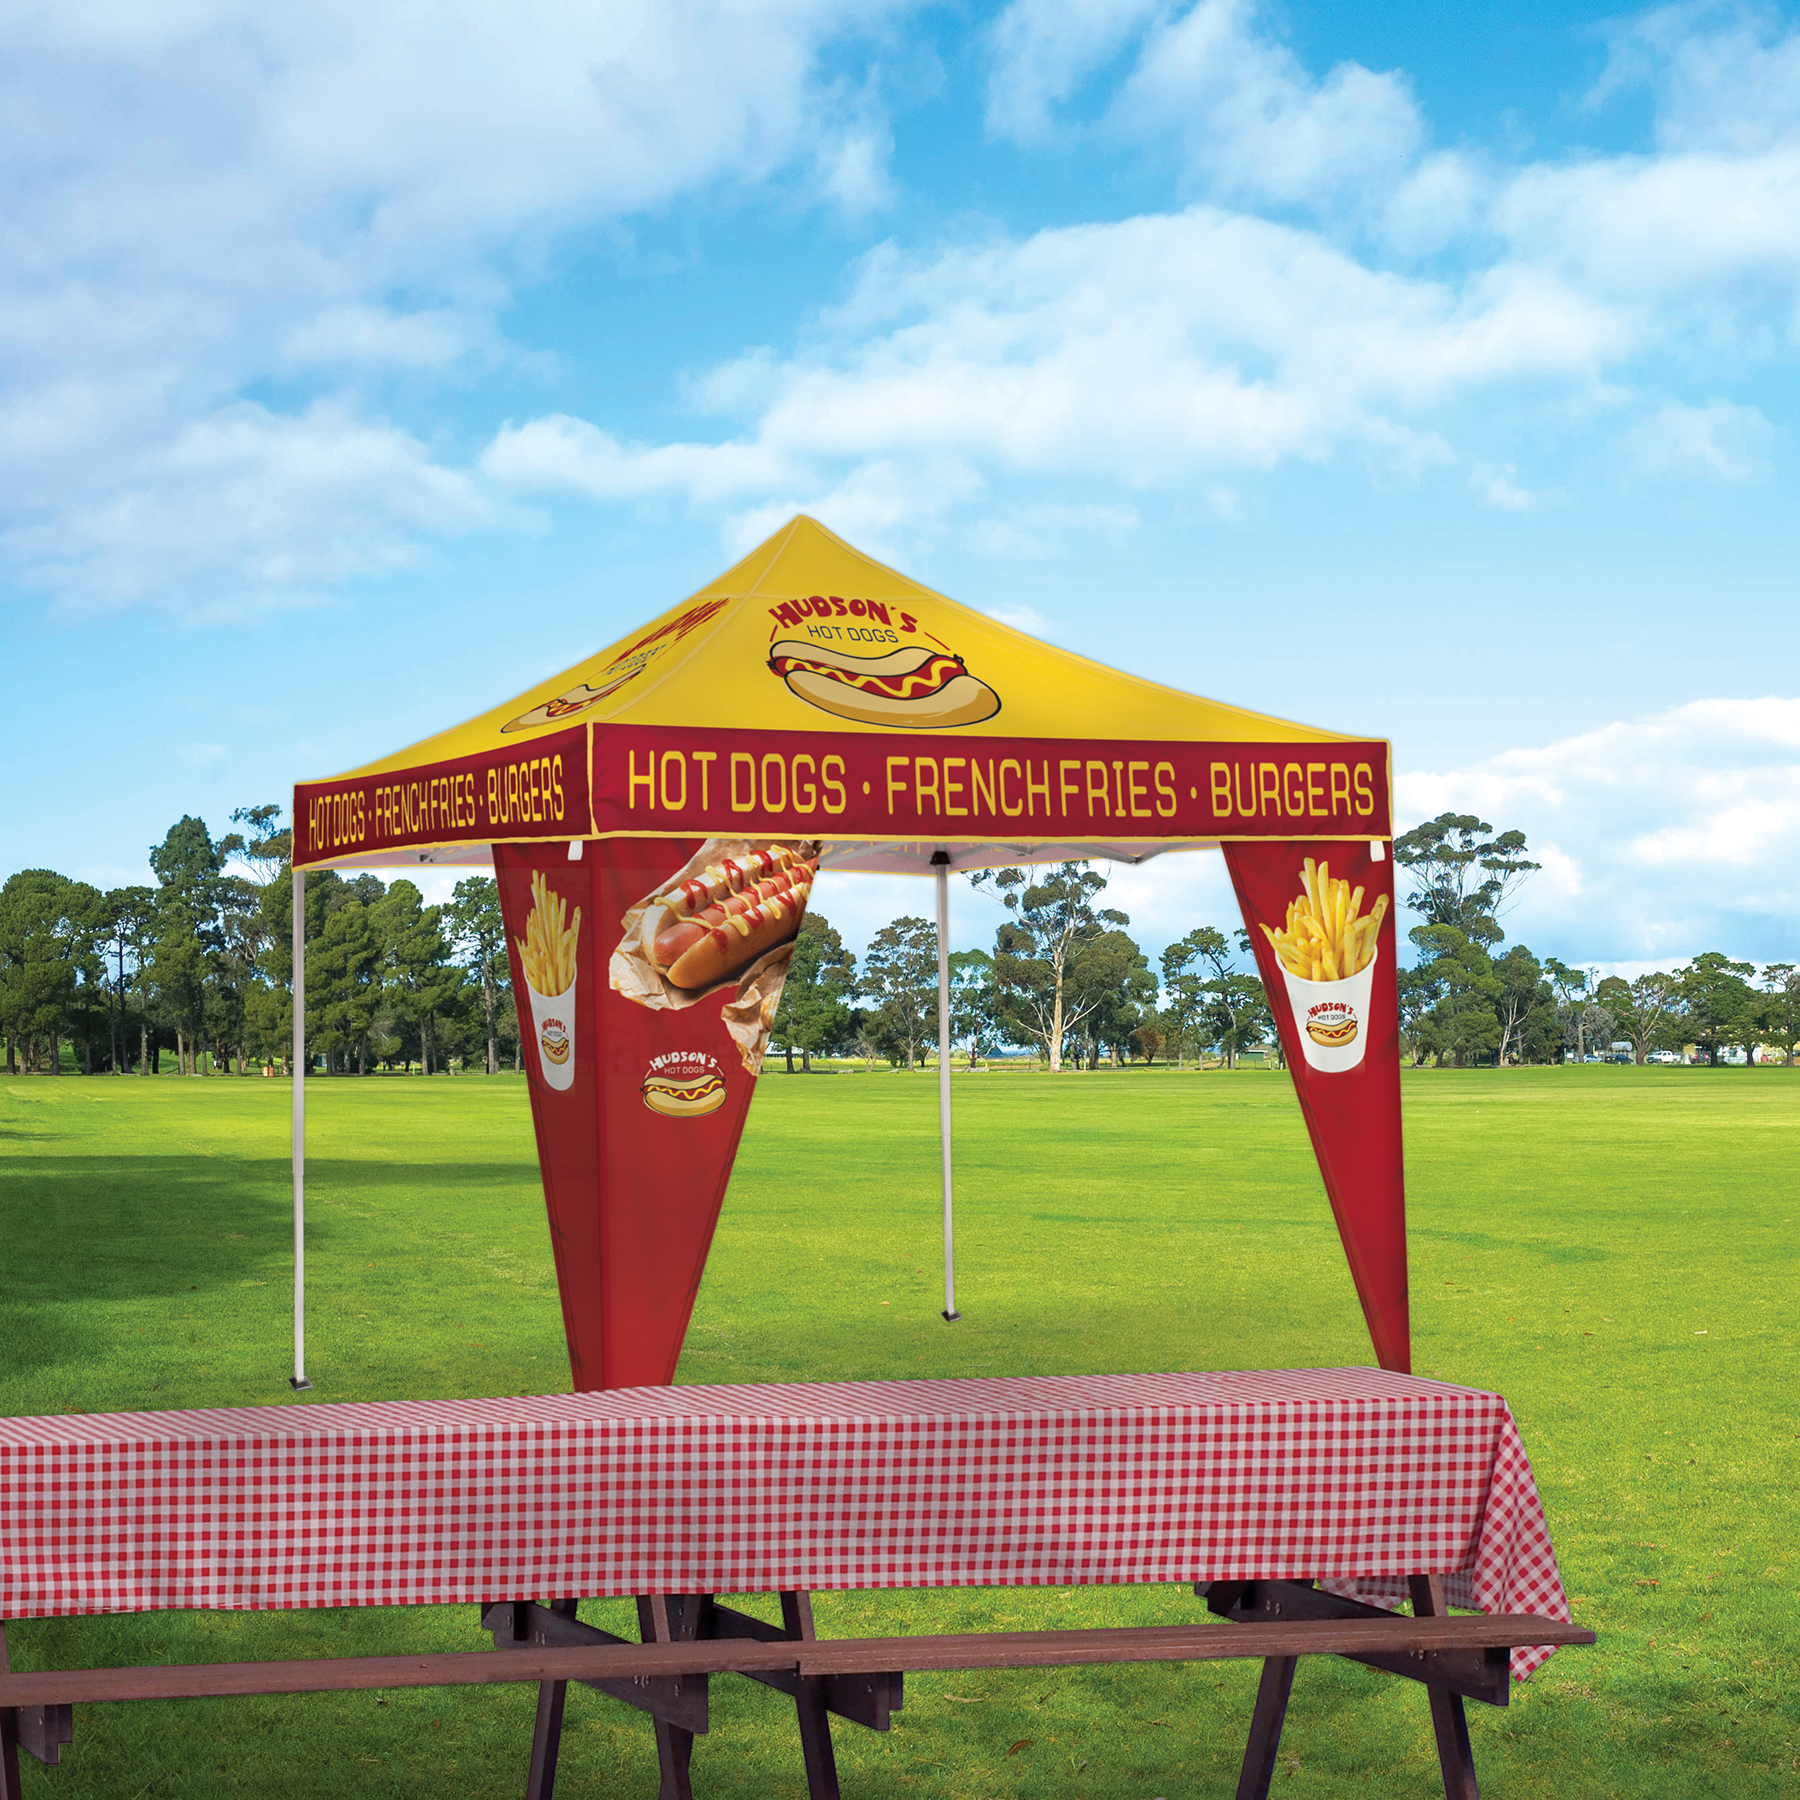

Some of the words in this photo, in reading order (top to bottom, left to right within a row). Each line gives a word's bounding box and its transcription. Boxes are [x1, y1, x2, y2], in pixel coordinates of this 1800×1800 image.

[768, 595, 918, 633] HUDSON'S
[807, 625, 842, 640] HOT
[847, 627, 899, 643] DOGS
[629, 750, 717, 811] HOT
[731, 752, 847, 814] DOGS
[887, 756, 1050, 816] FRENCH
[1059, 760, 1177, 817] FRIES
[1210, 762, 1374, 817] BURGERS
[309, 796, 332, 851] HOT
[333, 791, 366, 846] DOGS
[487, 754, 565, 825] BURGERS
[1307, 1002, 1355, 1018] HUDSON'S
[649, 1051, 718, 1071] HUDSON'S
[664, 1066, 681, 1074] HOT
[682, 1065, 705, 1074] DOGS
